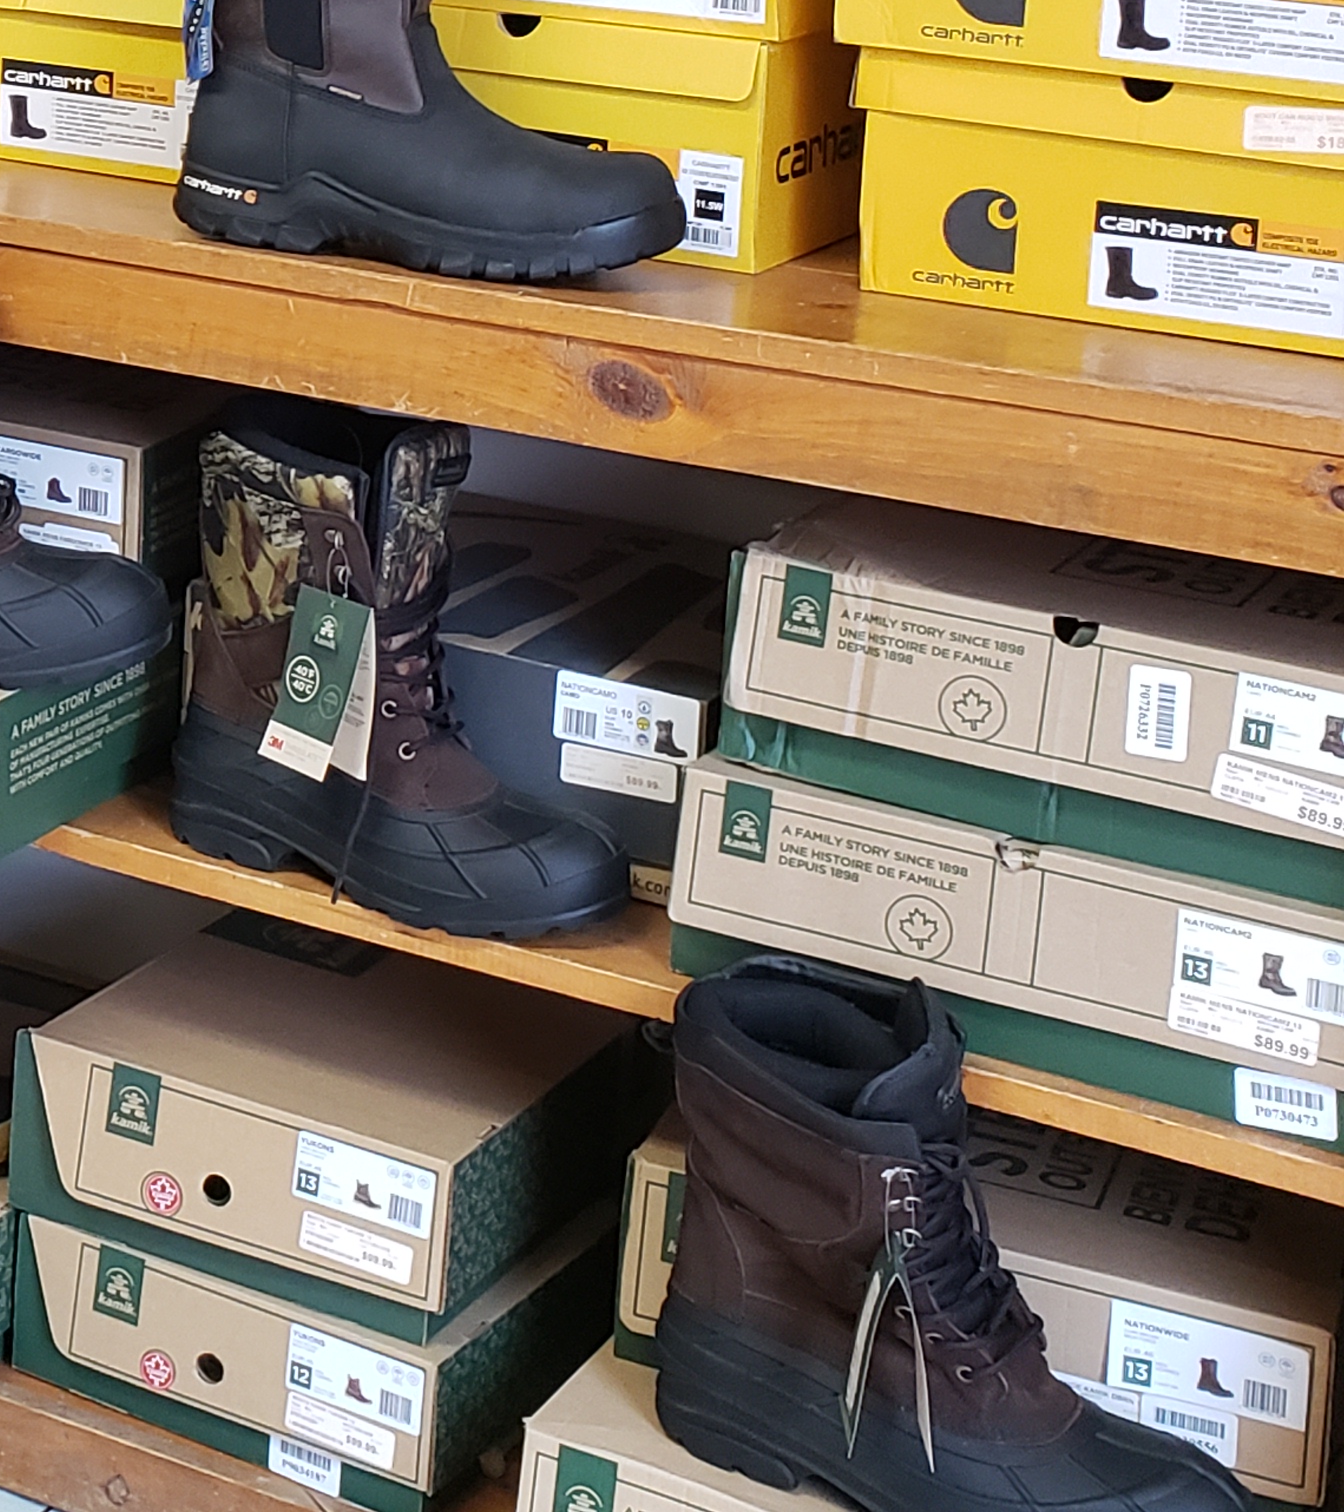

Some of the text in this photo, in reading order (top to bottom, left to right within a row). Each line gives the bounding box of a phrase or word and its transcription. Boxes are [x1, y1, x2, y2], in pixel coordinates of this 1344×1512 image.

[4, 69, 92, 91] carhartt
[183, 174, 243, 202] carhartt
[1099, 214, 1227, 242] carhartt
[840, 610, 1025, 656] A FAMILY STORY SINCE 1898
[837, 640, 913, 664] DEPUIS 1898
[839, 626, 1013, 672] UNE HISTOIRE DE FAMILLE
[21, 705, 56, 734] FAMILY
[58, 688, 90, 715] STORY
[94, 672, 123, 698] SINCE
[267, 734, 284, 751] 3M
[1248, 722, 1266, 744] 11
[1184, 959, 1209, 981] 13
[1254, 1034, 1309, 1060] $89.99
[1255, 1105, 1319, 1127] P0730473
[1123, 1318, 1190, 1342] NATIONWIDE
[1126, 1361, 1149, 1381] 13
